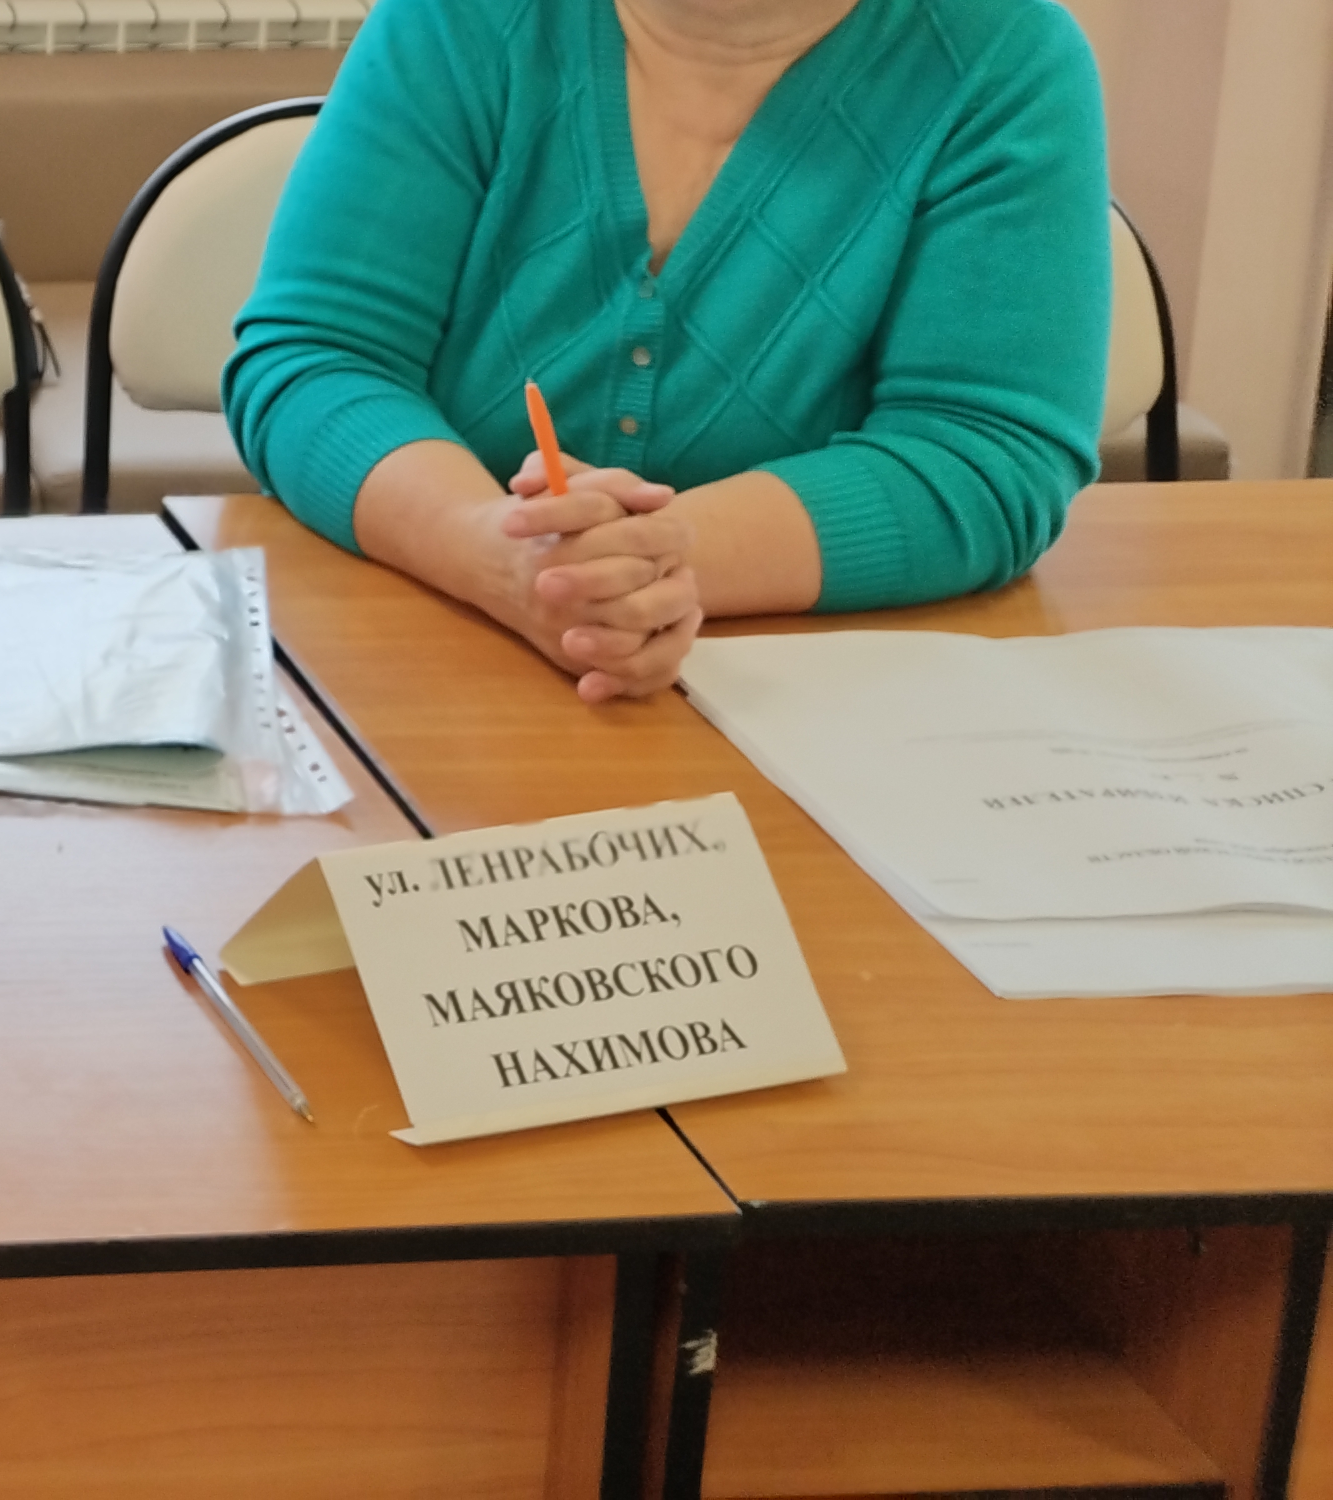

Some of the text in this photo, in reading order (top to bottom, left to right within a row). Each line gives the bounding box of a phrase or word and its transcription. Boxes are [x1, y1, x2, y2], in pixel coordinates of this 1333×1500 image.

[364, 866, 420, 907] ул.
[457, 892, 682, 953] МАРКОВА,
[421, 943, 760, 1029] МАЯКОВСКОГО
[489, 1017, 748, 1090] НАХИМОВА
